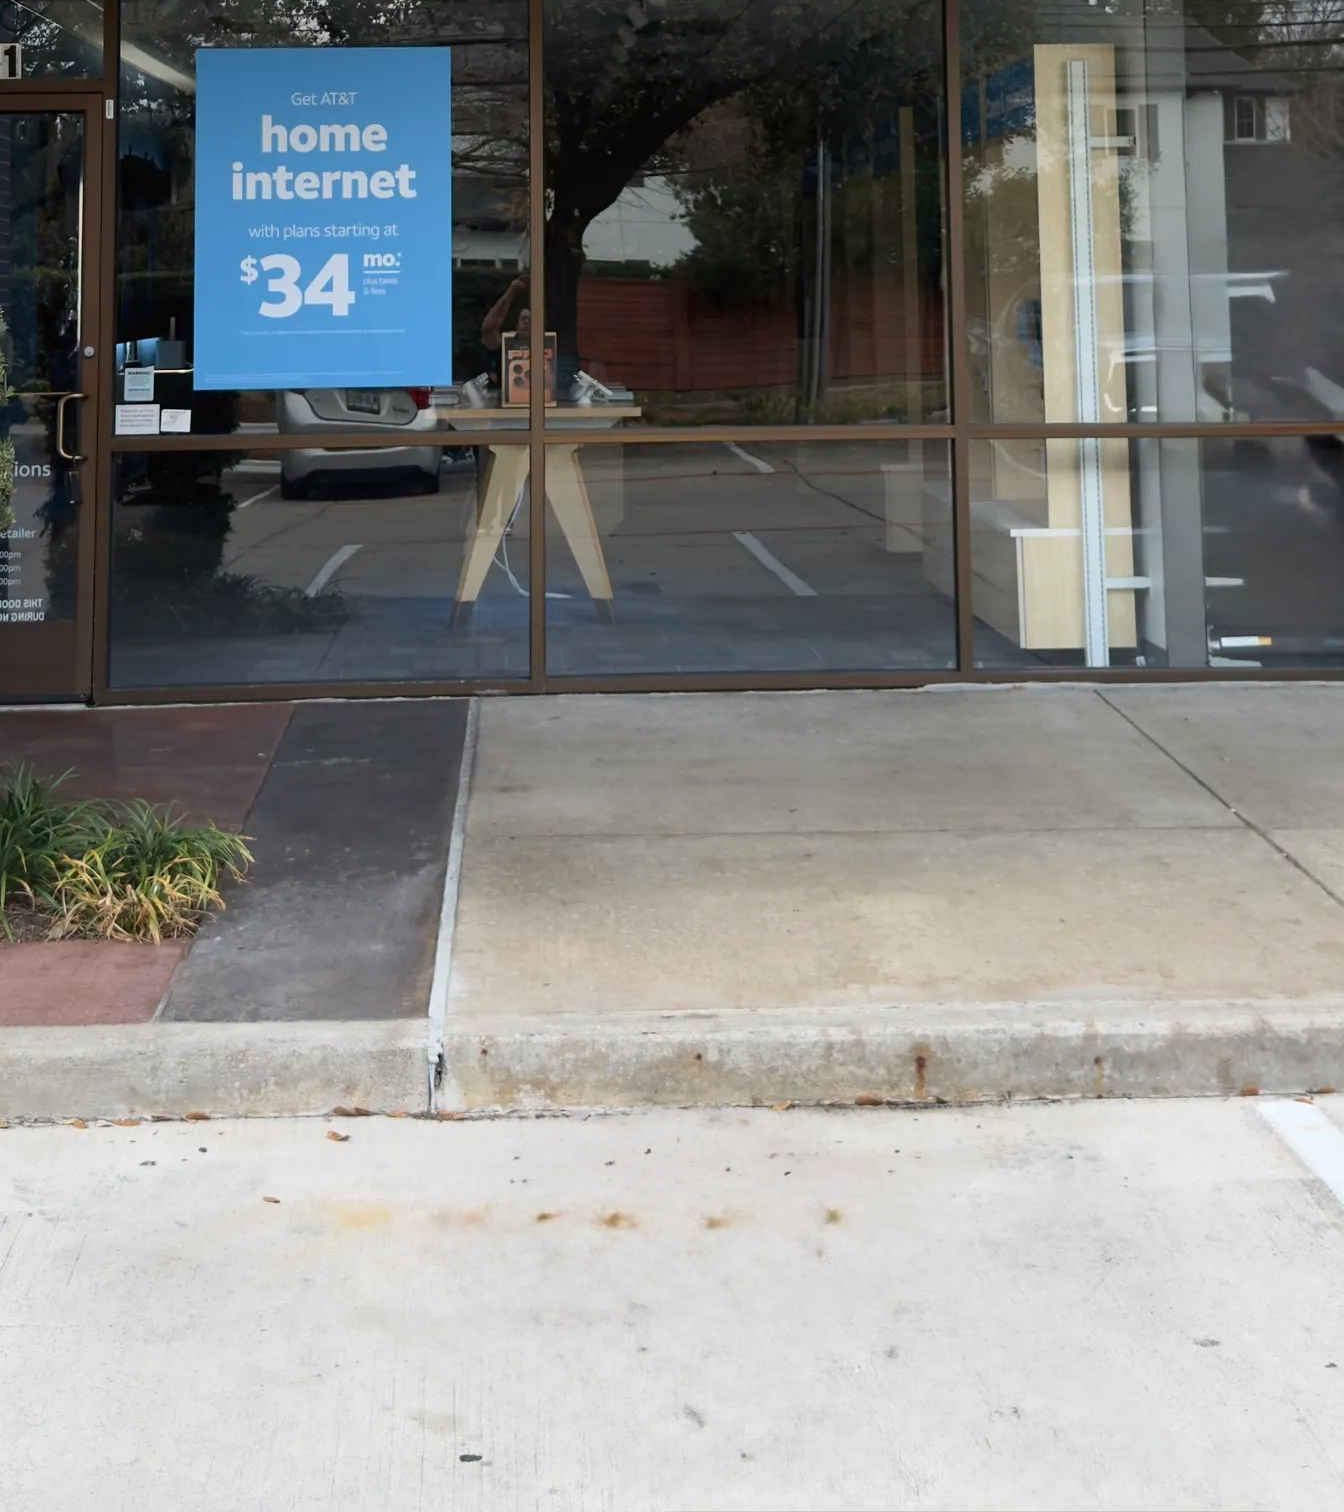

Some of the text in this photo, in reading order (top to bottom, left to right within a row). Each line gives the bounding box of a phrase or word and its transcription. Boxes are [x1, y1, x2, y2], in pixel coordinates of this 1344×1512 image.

[291, 92, 357, 106] Get AT&T
[261, 114, 388, 154] home
[232, 161, 417, 200] internet
[248, 223, 399, 240] with plans starting at
[363, 277, 378, 286] plus
[371, 287, 386, 295] fees
[0, 528, 37, 539] etailer
